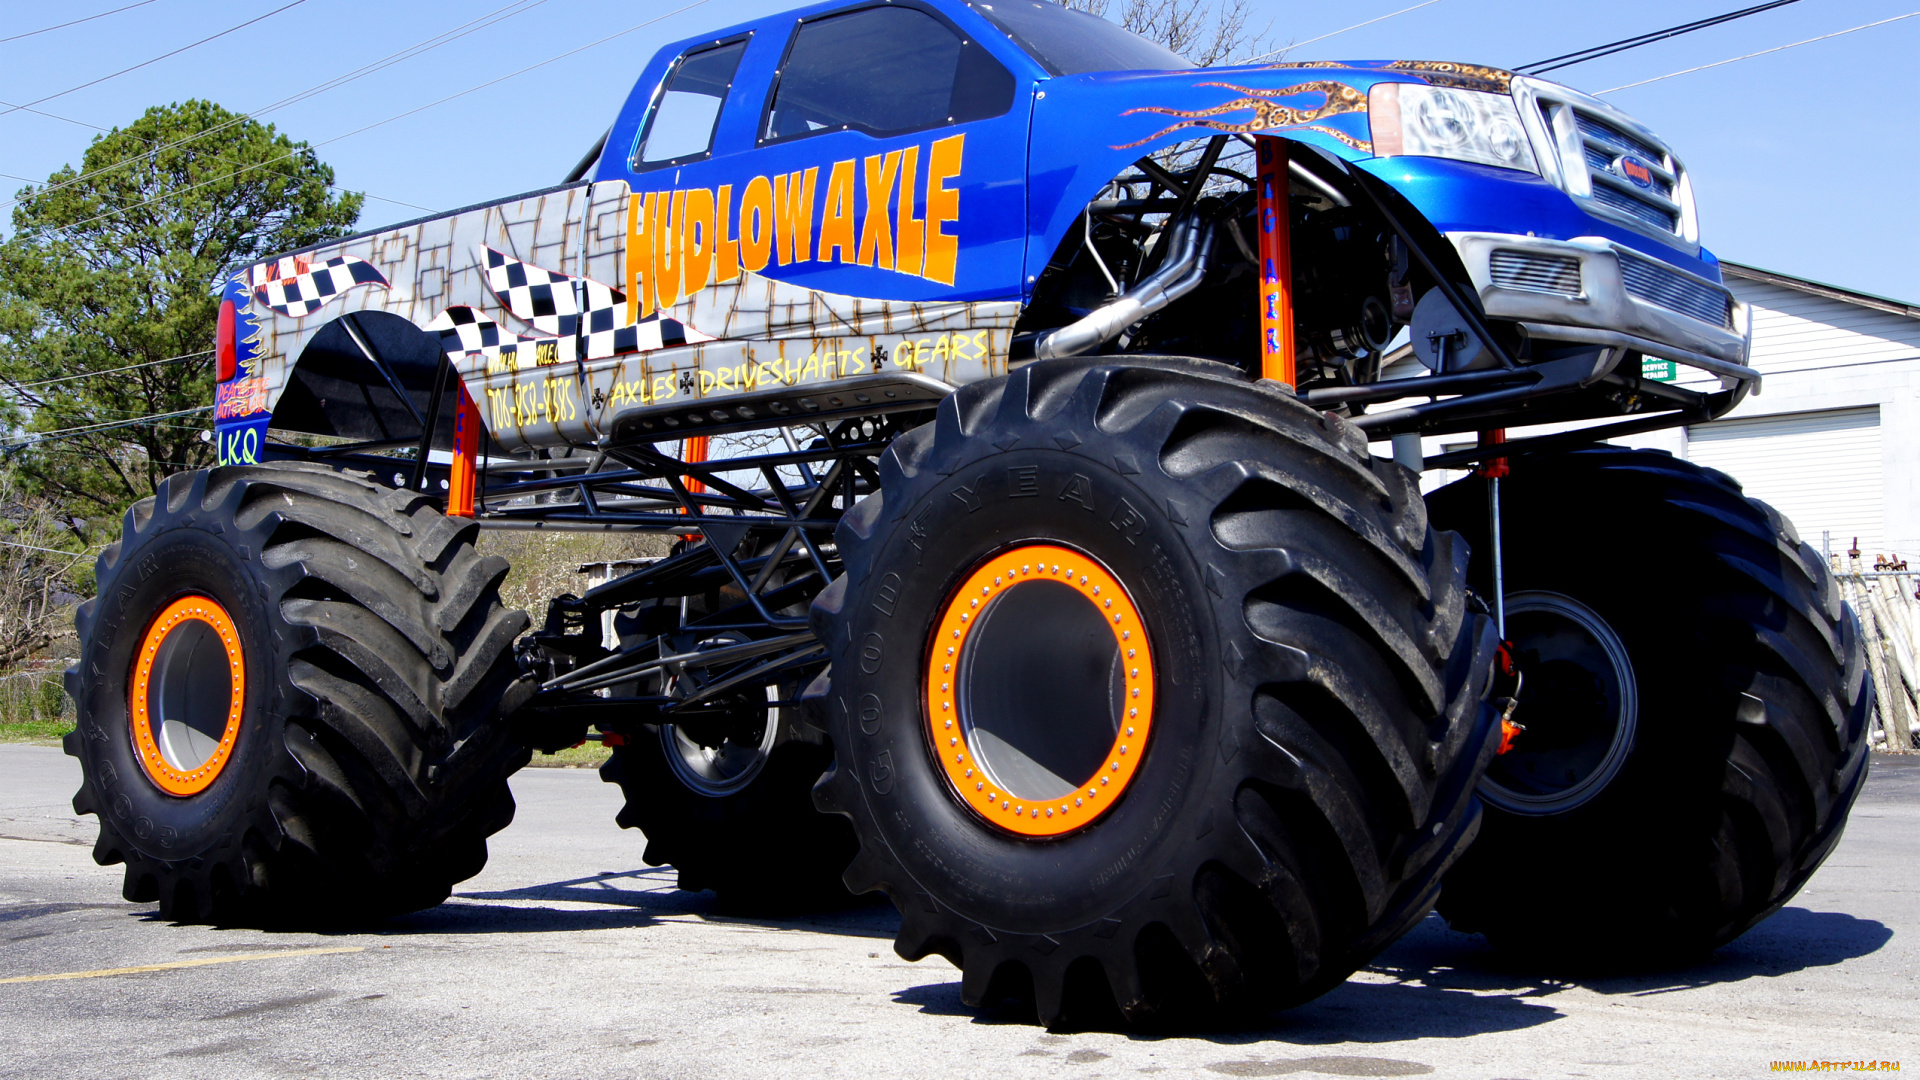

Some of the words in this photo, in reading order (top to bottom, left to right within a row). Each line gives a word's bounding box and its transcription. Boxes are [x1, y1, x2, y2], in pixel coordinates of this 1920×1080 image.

[1260, 139, 1277, 234] BIG
[1265, 258, 1280, 355] AIR
[487, 376, 576, 431] 706-858-8385
[610, 373, 678, 408] AXLES
[698, 346, 866, 395] DRIVESHAFTS
[893, 330, 988, 366] GEARS
[217, 427, 259, 467] LKQ
[456, 386, 466, 457] AIR
